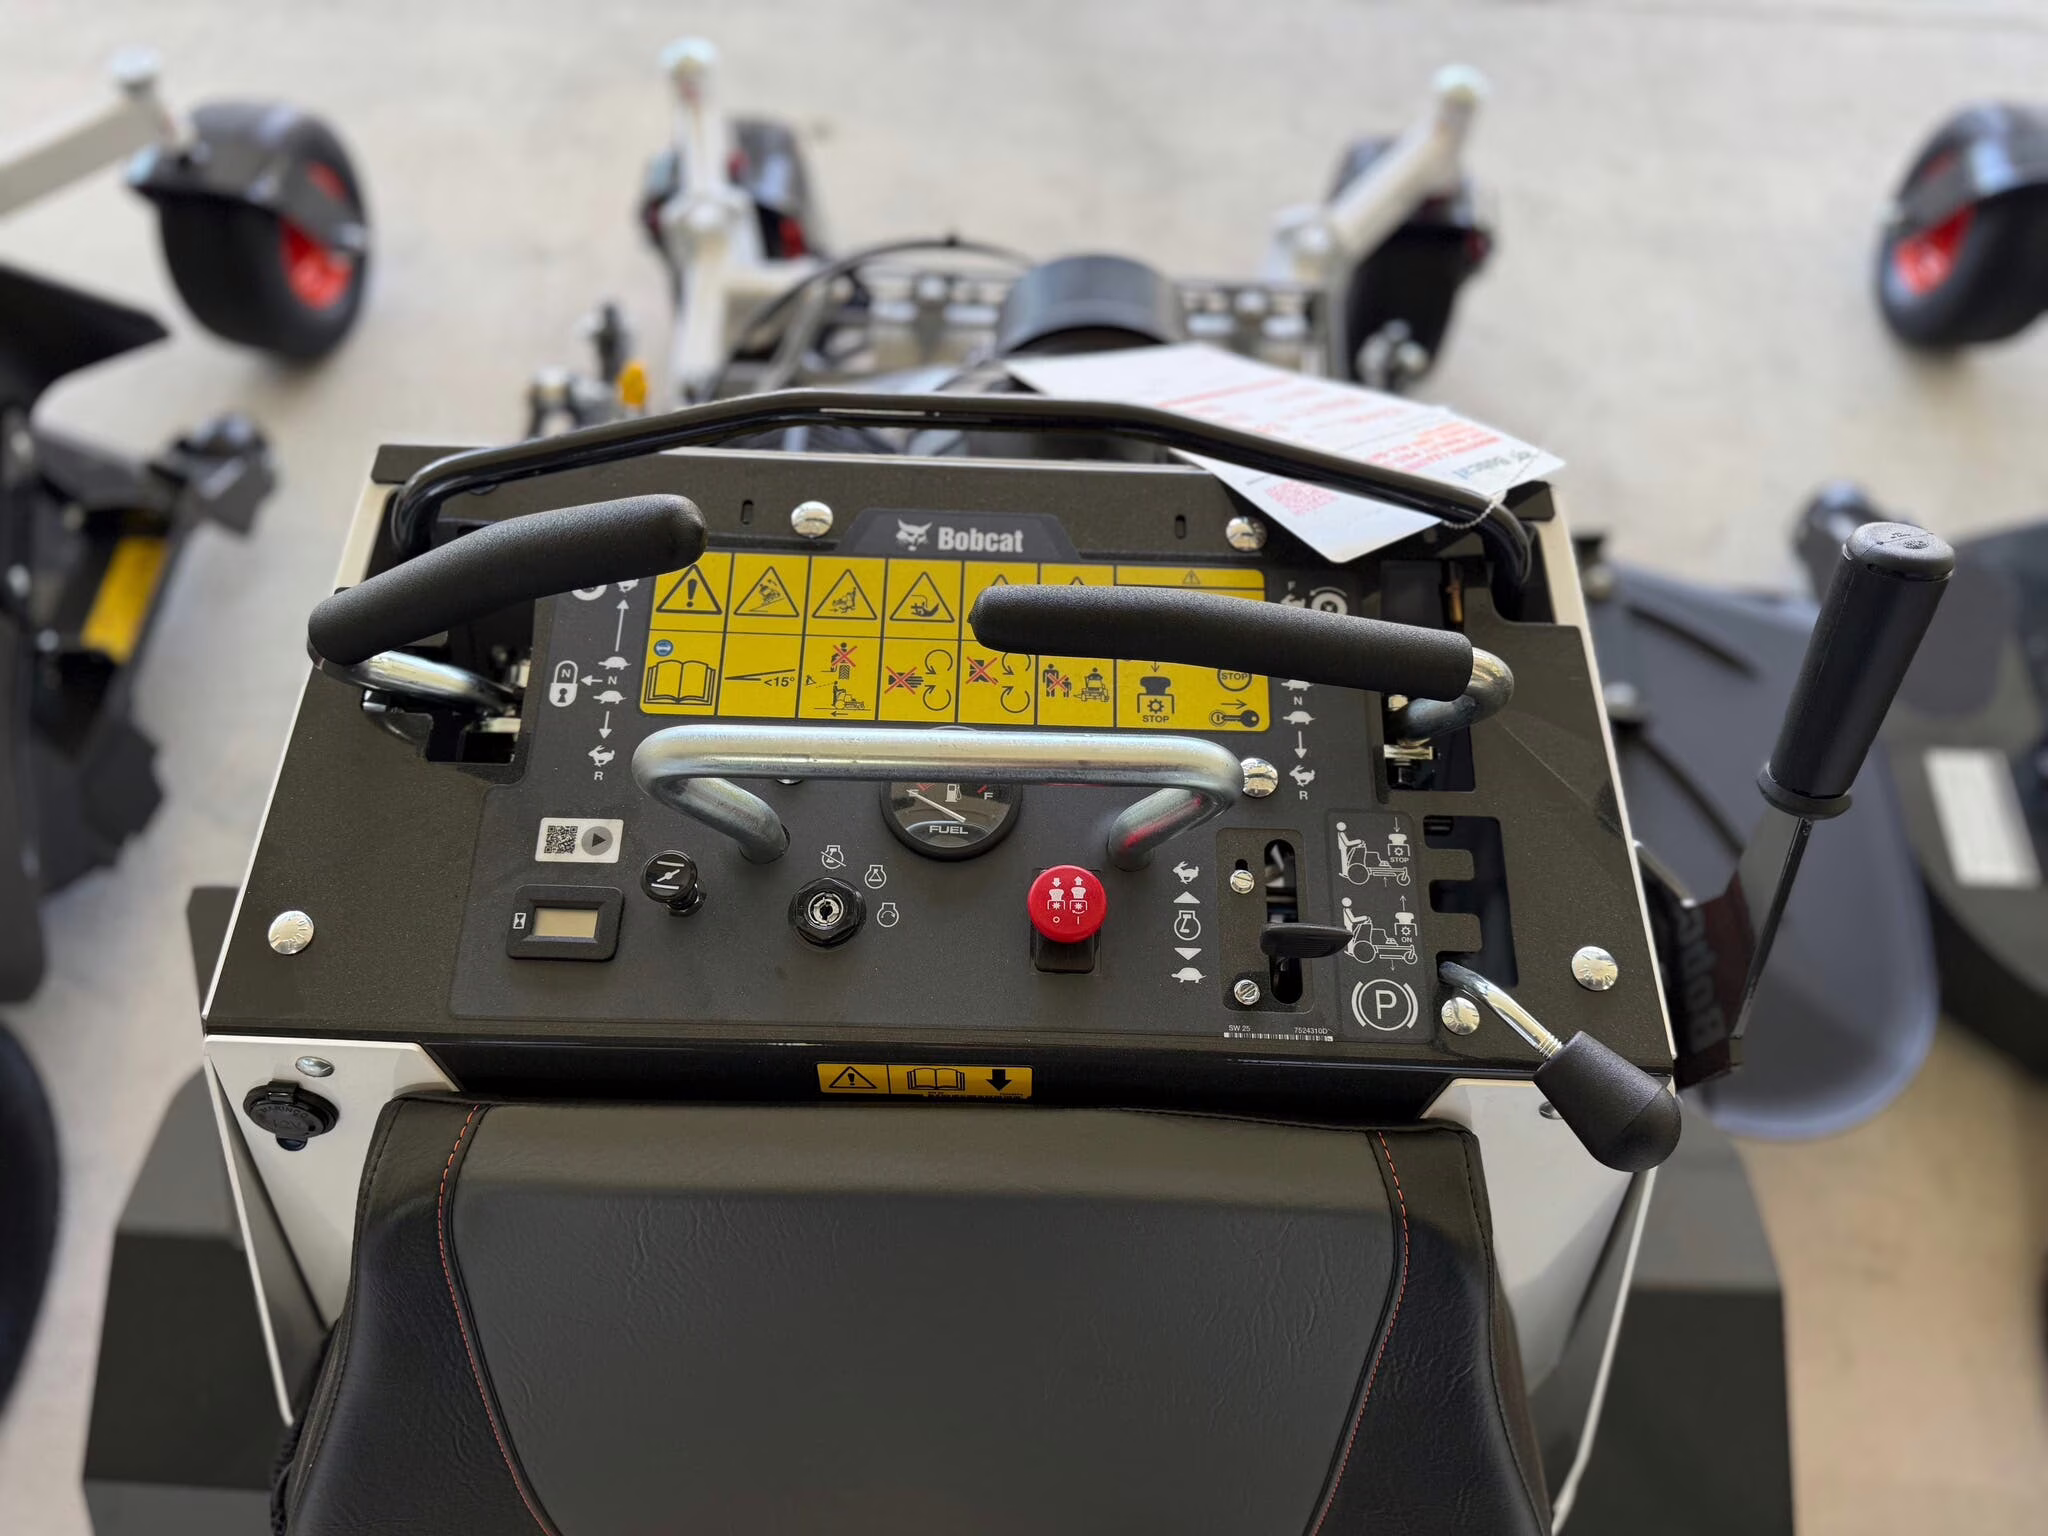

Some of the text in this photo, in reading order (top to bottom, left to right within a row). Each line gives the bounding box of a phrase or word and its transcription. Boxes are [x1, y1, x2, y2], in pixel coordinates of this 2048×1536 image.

[938, 526, 1023, 553] Bobcat
[561, 668, 571, 678] N
[1221, 672, 1249, 681] STOP
[607, 676, 618, 685] N
[1293, 696, 1303, 705] N
[1142, 714, 1170, 723] STOP
[593, 771, 604, 780] R
[983, 792, 993, 800] F
[1299, 790, 1309, 800] R
[929, 825, 969, 835] FUEL
[1374, 989, 1397, 1020] P
[1228, 1024, 1241, 1032] SW
